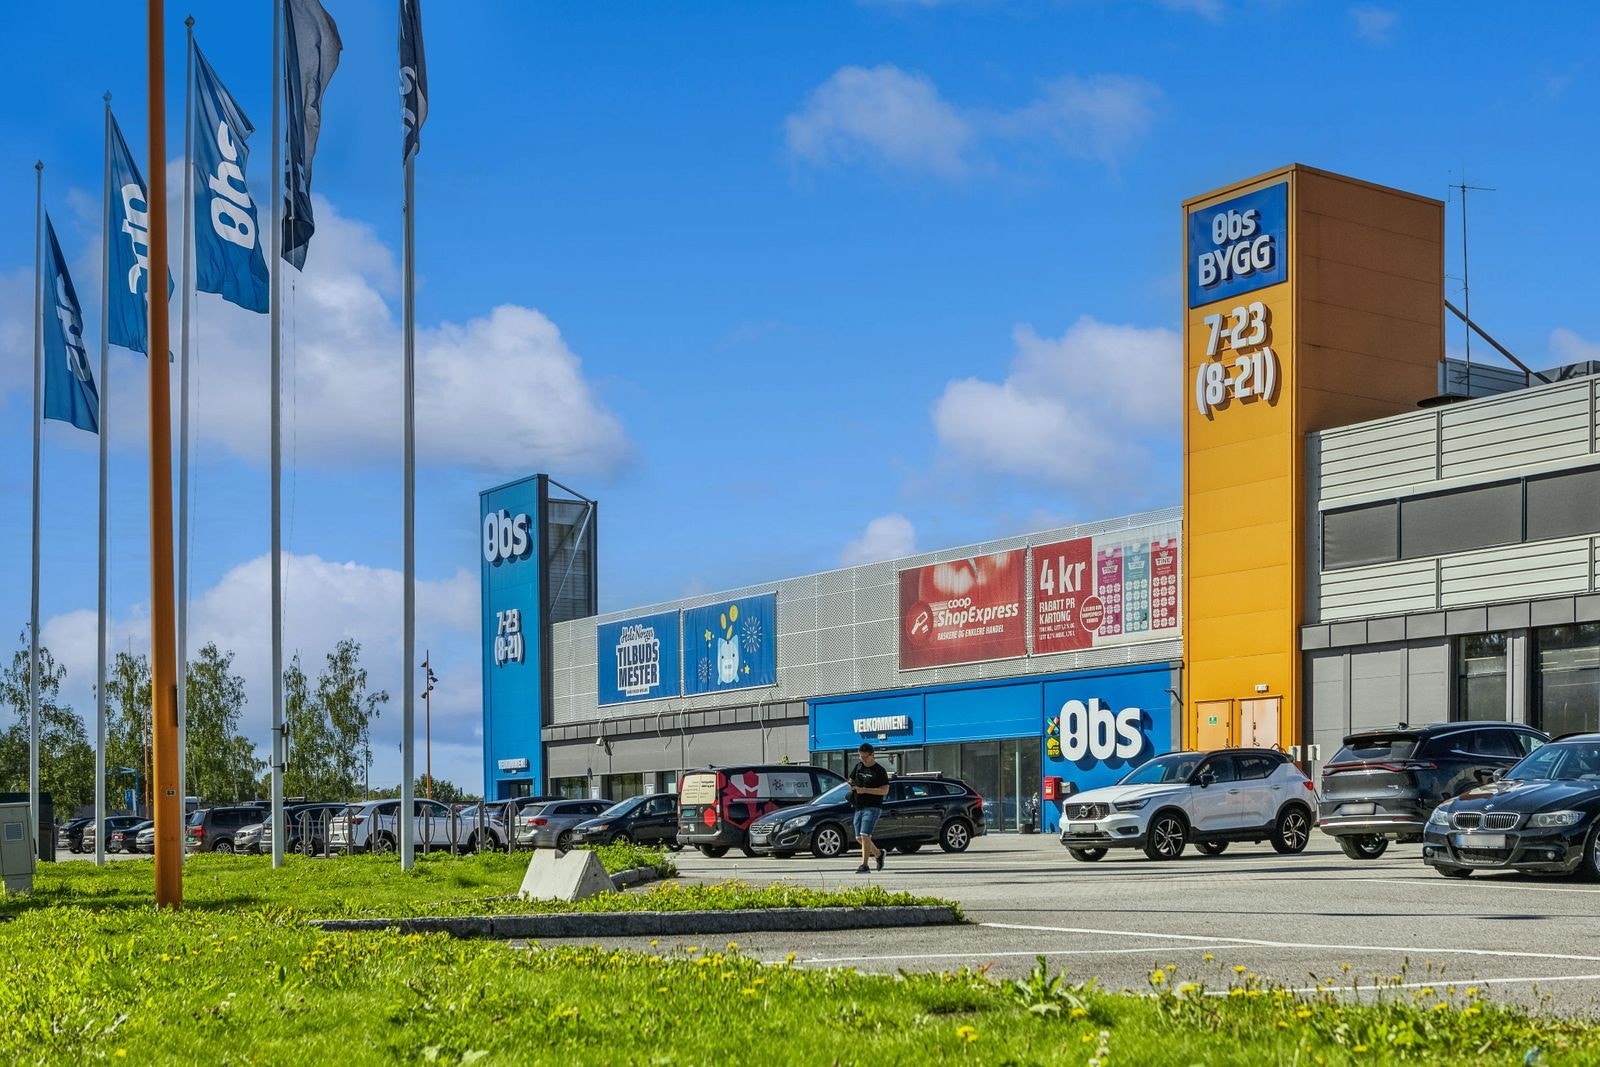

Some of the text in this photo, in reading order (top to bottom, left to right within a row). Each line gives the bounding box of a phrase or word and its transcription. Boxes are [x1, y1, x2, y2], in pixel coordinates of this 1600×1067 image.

[1212, 209, 1256, 245] Obs
[1199, 234, 1271, 287] BYGG
[1204, 301, 1267, 356] 7-23
[1196, 346, 1277, 415] (8-21)
[484, 510, 527, 562] Obs
[1040, 556, 1086, 595] 4 kr
[938, 603, 1019, 628] ShopExpress
[948, 597, 971, 609] coop
[1040, 599, 1065, 613] RABATT
[1066, 597, 1075, 610] PR
[1040, 610, 1070, 625] KARTONG
[618, 641, 658, 667] TILBUDS
[619, 663, 657, 688] MESTER
[1059, 698, 1143, 762] Obs
